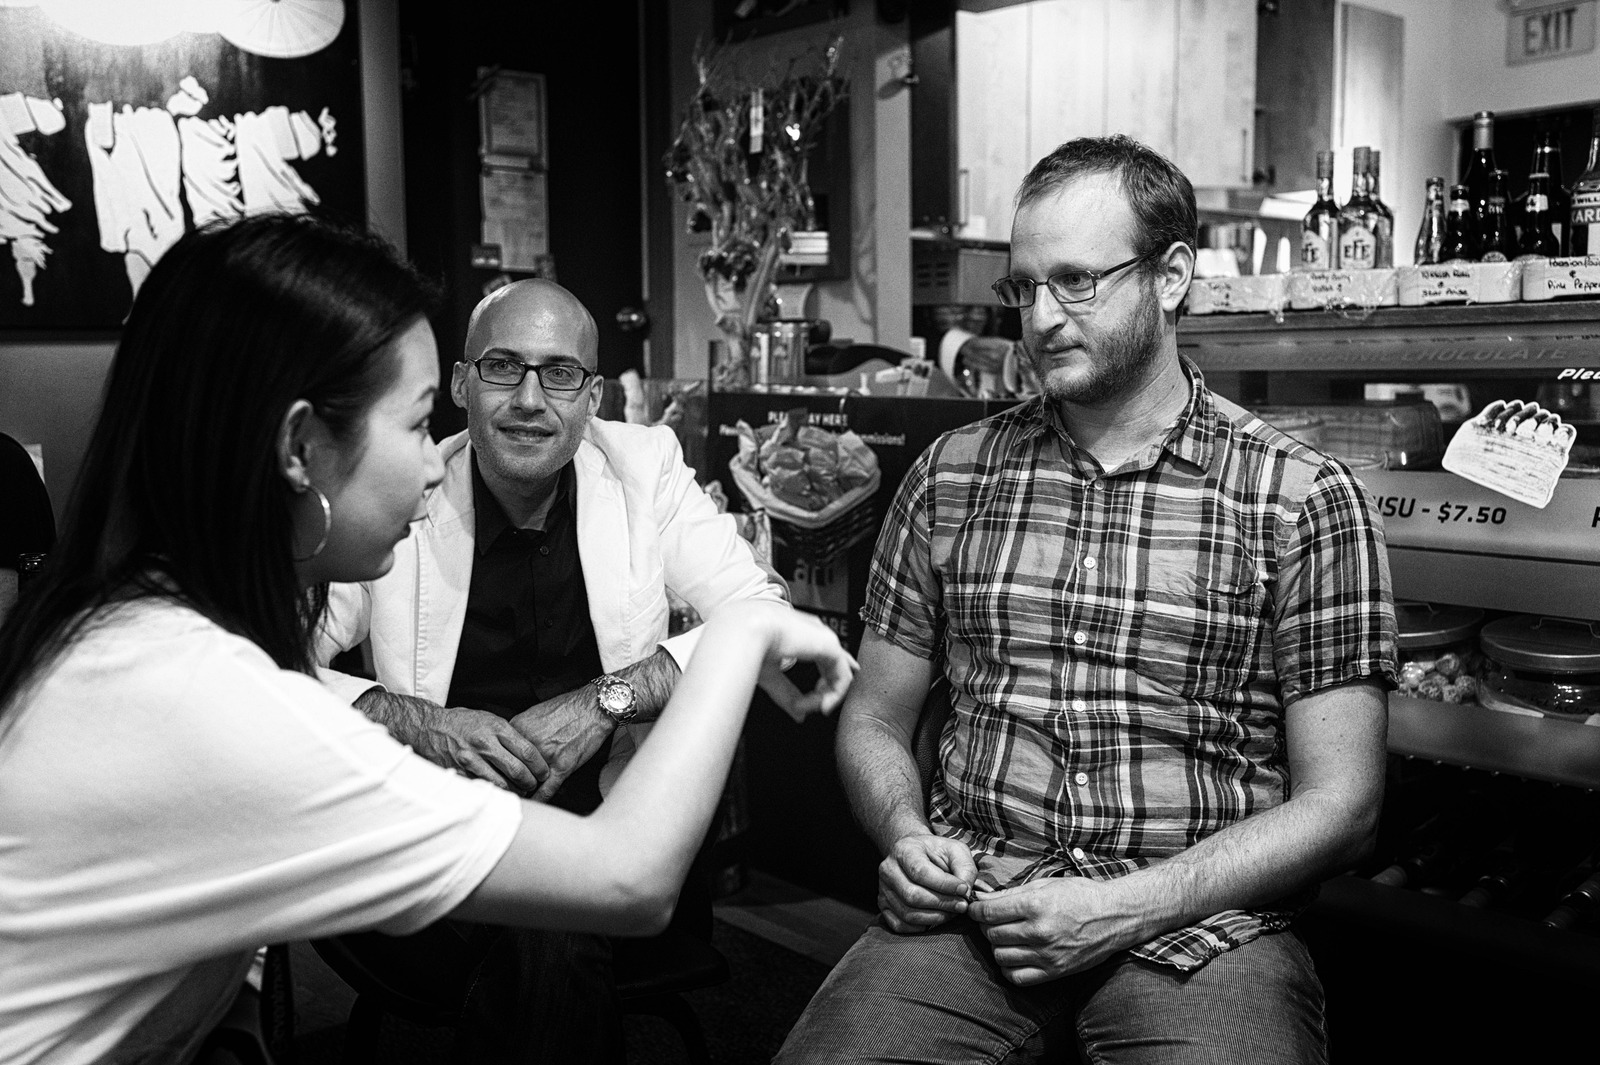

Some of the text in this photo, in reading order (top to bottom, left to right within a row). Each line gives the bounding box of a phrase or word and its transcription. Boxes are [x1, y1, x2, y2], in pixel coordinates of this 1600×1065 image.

[1524, 7, 1578, 56] EXIT
[1344, 239, 1371, 261] EFE
[1374, 496, 1416, 518] ISU
[1437, 501, 1507, 525] $7.50
